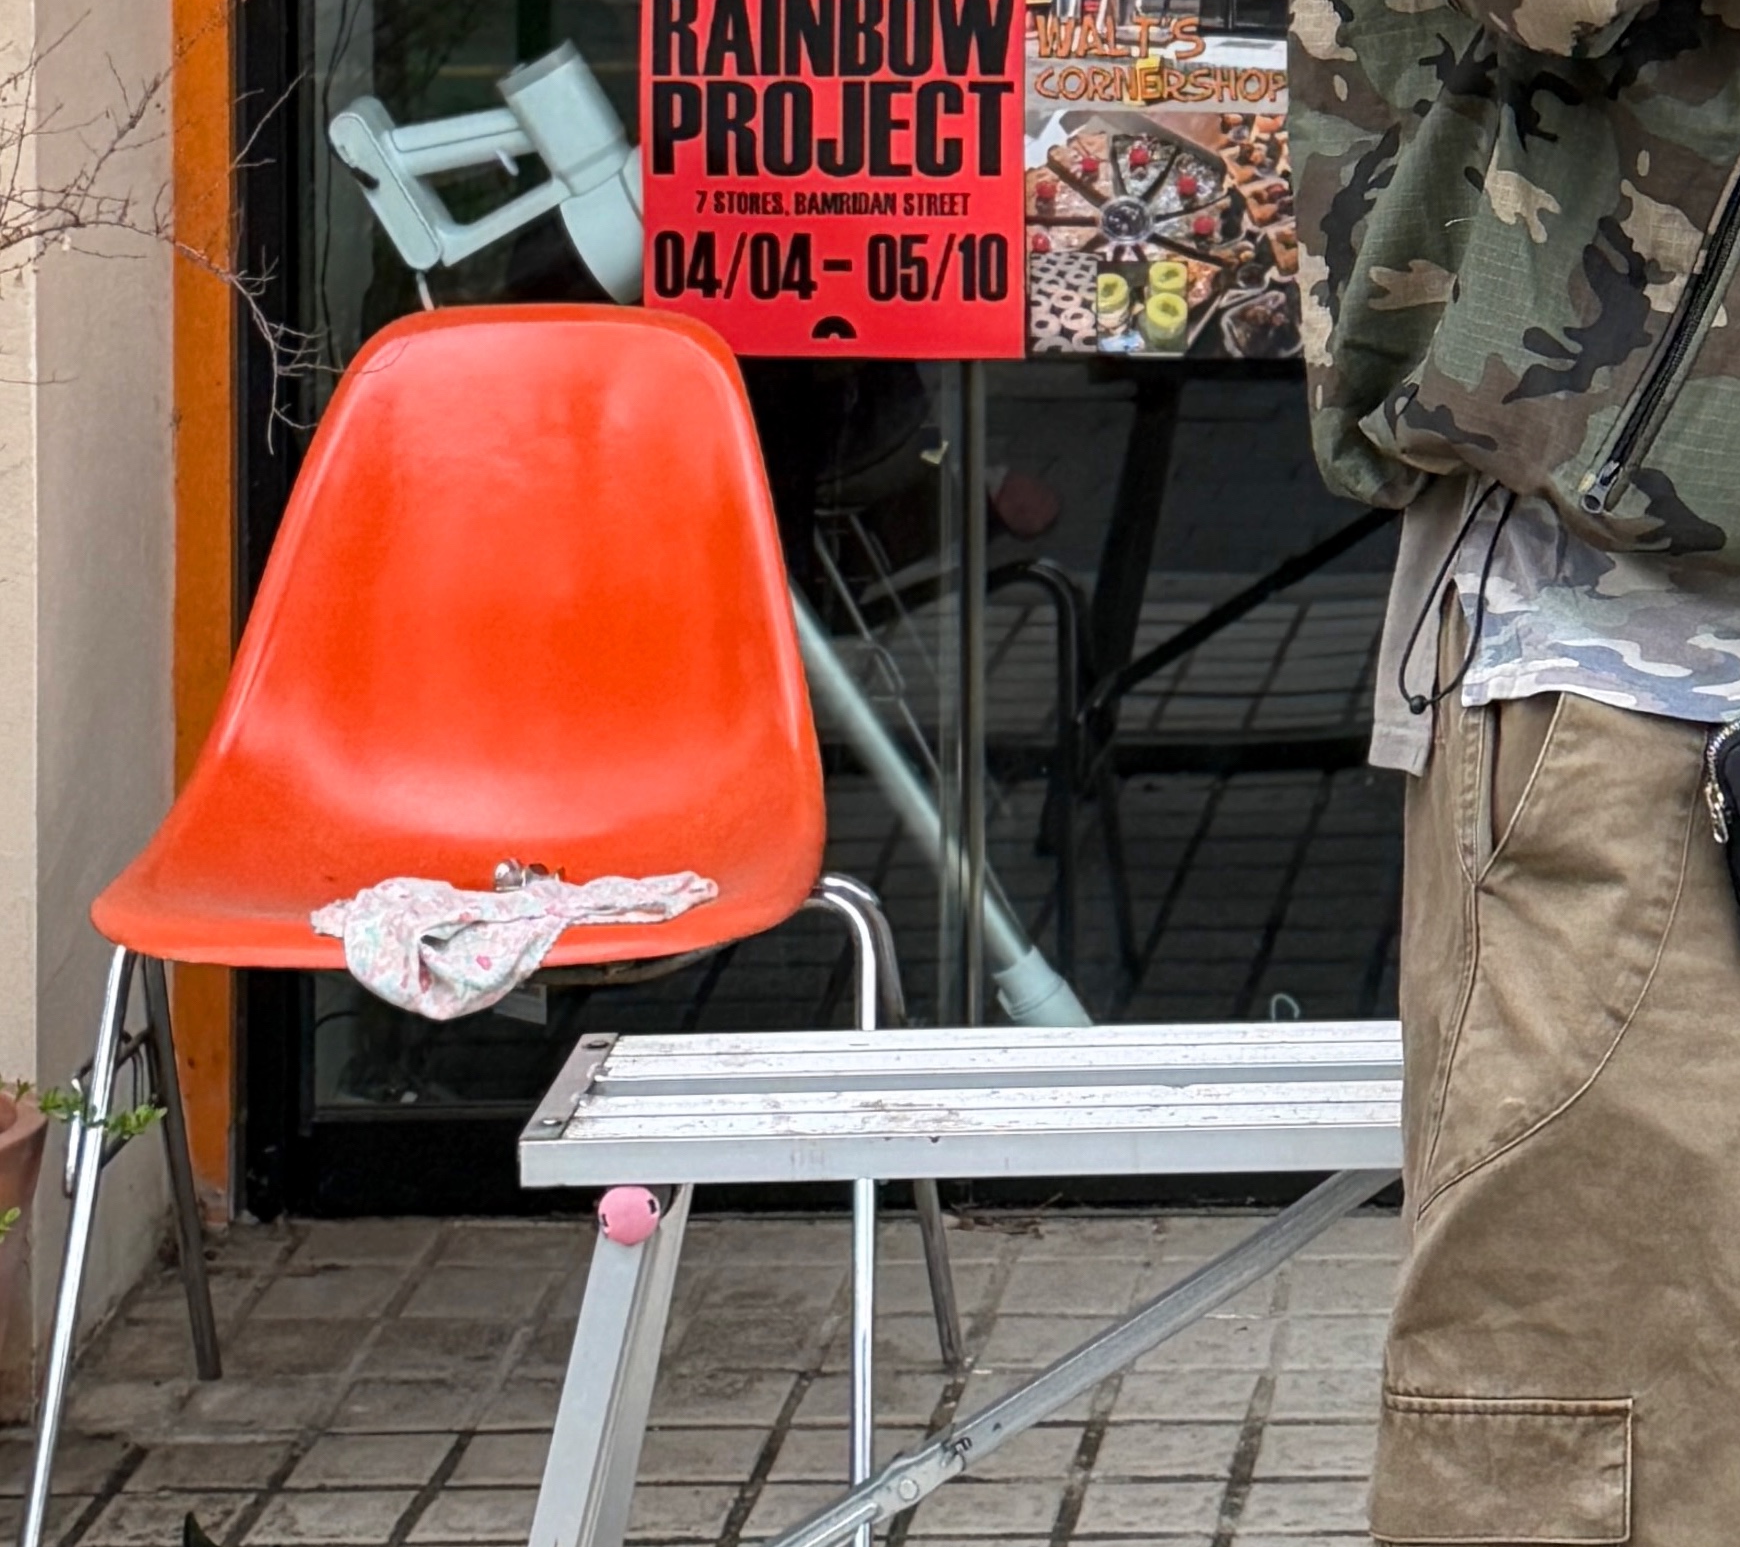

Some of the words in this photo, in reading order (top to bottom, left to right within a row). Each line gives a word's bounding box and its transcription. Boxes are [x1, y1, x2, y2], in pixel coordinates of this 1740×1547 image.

[1035, 14, 1207, 60] WALT'S
[1034, 65, 1288, 103] CORNERSHOP
[651, 80, 1014, 178] PROJECT
[696, 192, 705, 214] 7
[793, 192, 897, 216] BAMRIDAN
[903, 192, 971, 216] STREET
[867, 233, 1009, 303] 05/10
